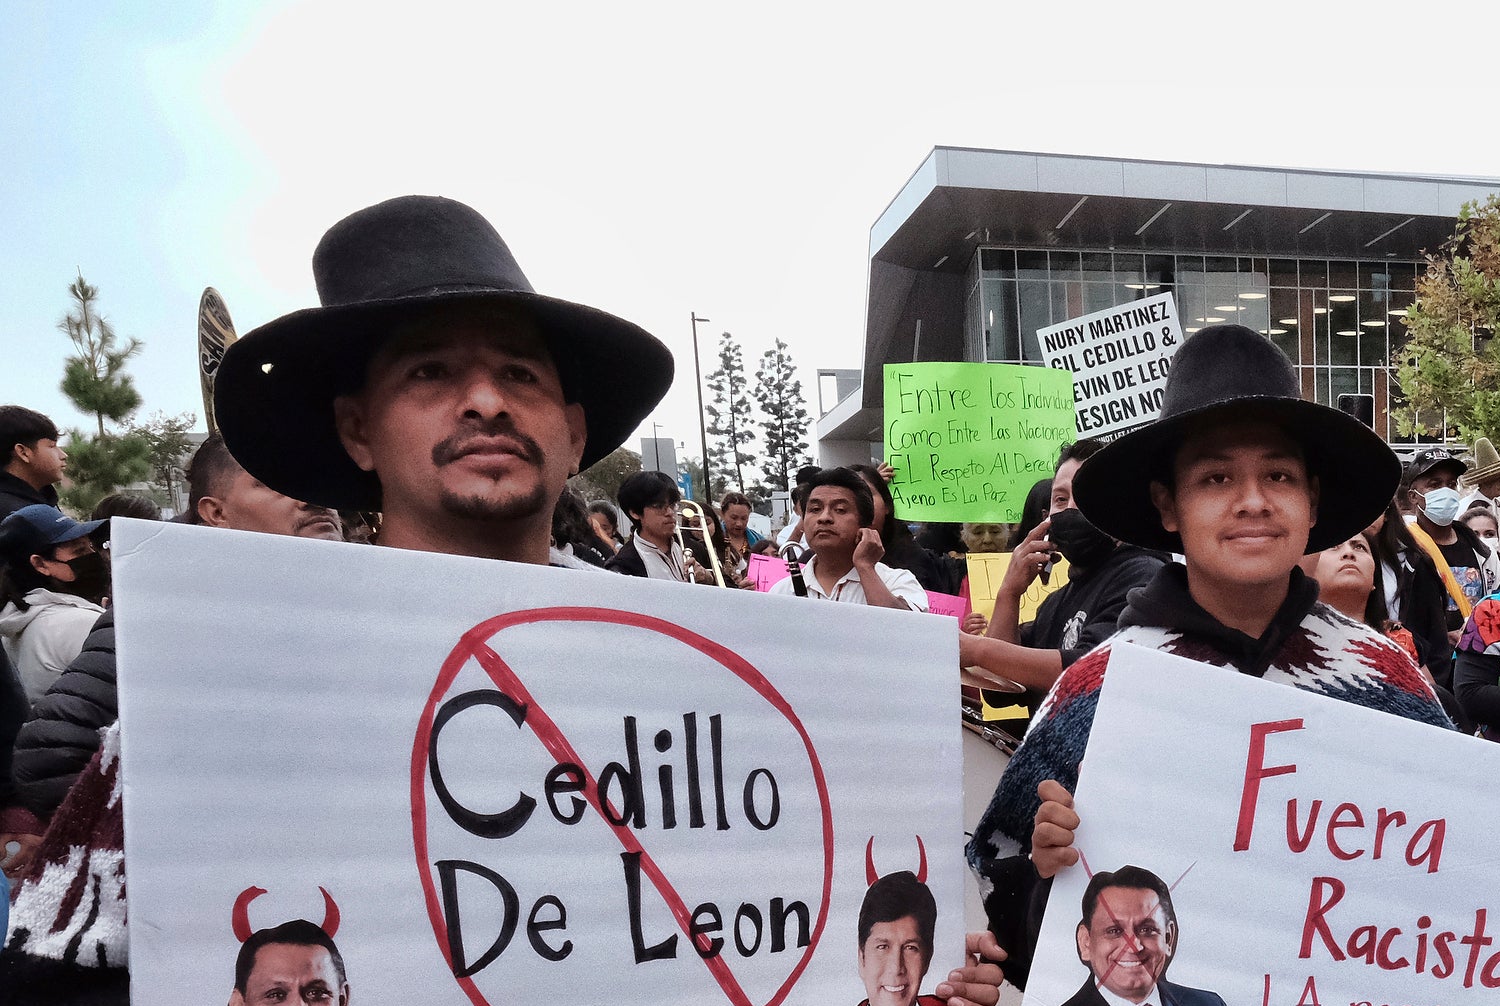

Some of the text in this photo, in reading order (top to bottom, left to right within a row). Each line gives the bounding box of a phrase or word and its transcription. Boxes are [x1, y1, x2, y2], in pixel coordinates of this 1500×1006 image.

[1044, 301, 1170, 352] NURY MARTINEZ
[1051, 326, 1177, 373] GIL CEDILLO &
[1073, 352, 1174, 403] EVIN DE LEÓ
[1138, 387, 1165, 416] NO
[889, 419, 941, 451] Como
[948, 419, 981, 445] Entre
[990, 417, 1011, 441] Las
[930, 454, 985, 486] Respeto
[990, 453, 1009, 475] Al
[892, 487, 936, 508] Ajeno
[942, 487, 957, 503] Es
[962, 486, 978, 504] La
[429, 689, 780, 839] Cedillo
[1233, 718, 1446, 873] Fuera
[434, 851, 811, 978] De Leon
